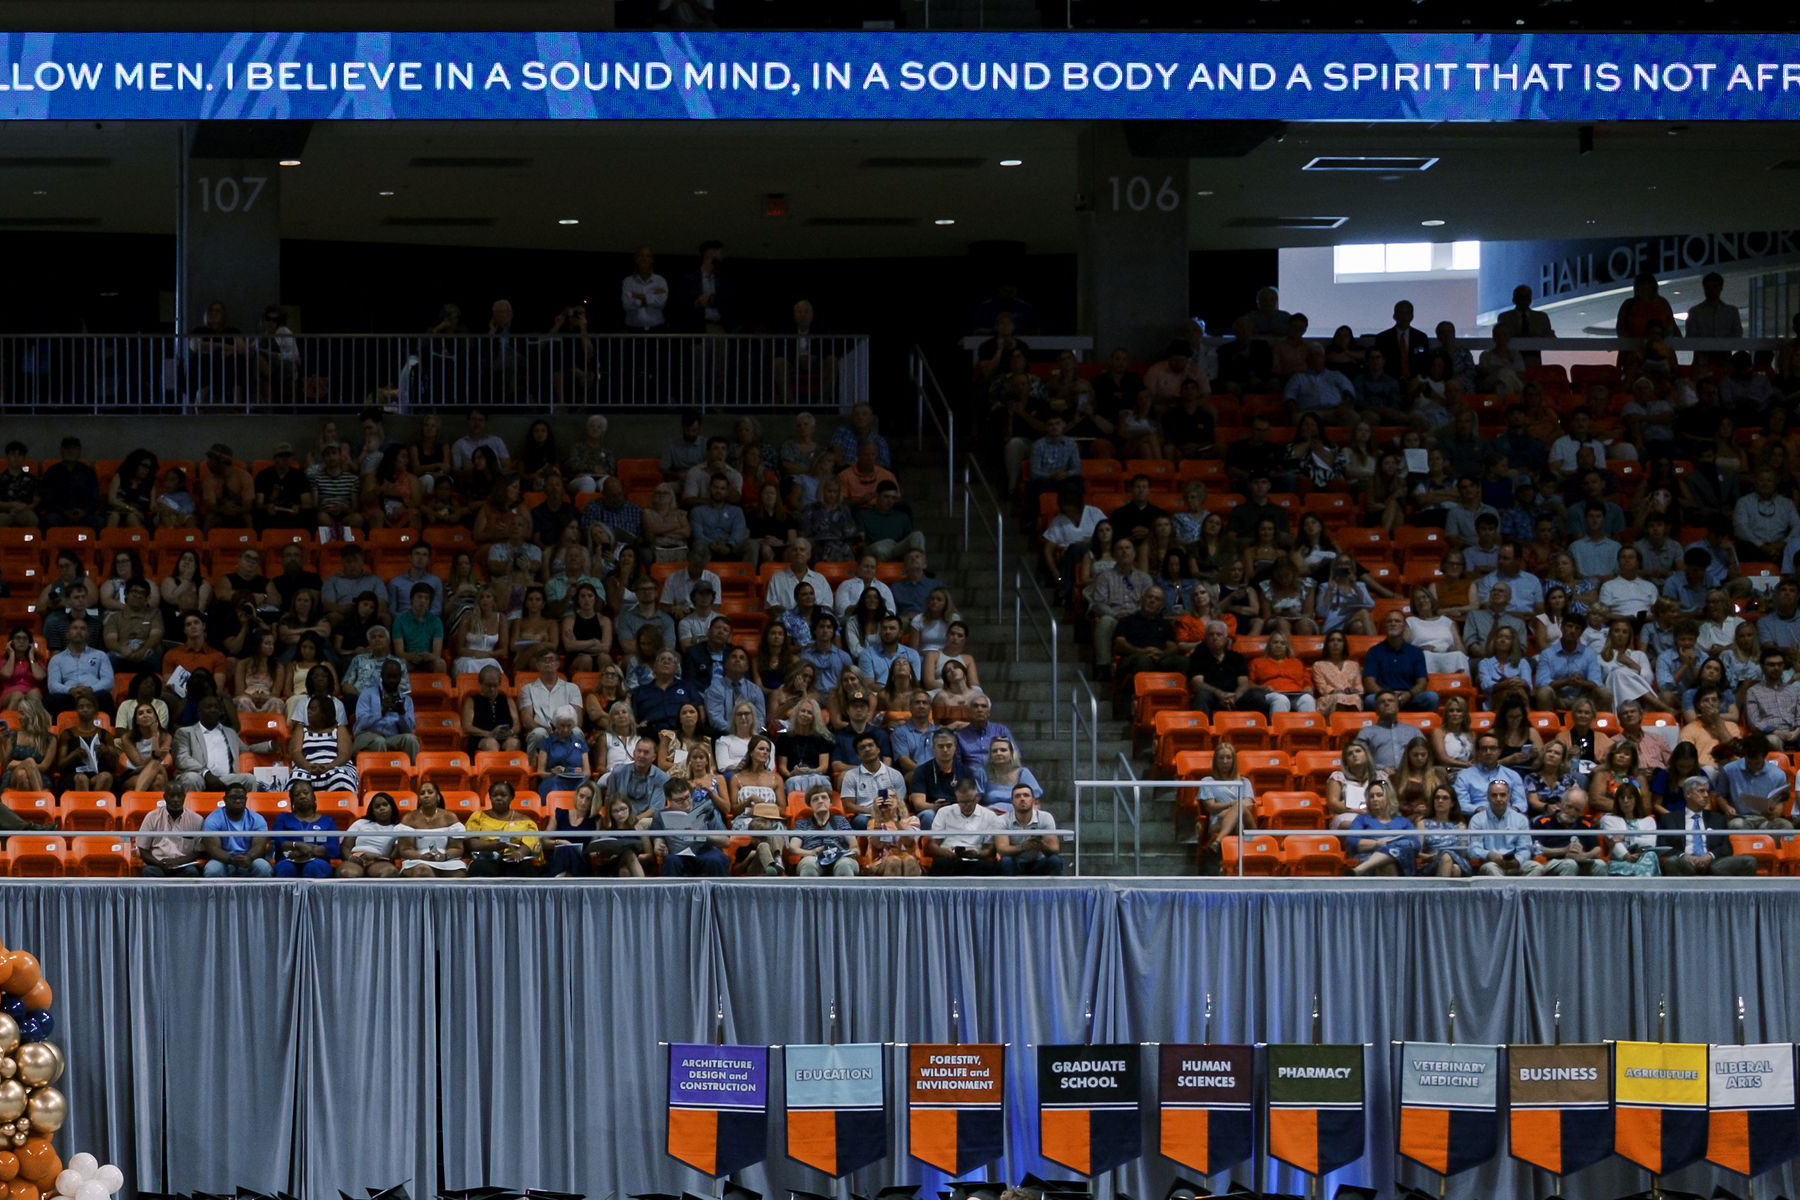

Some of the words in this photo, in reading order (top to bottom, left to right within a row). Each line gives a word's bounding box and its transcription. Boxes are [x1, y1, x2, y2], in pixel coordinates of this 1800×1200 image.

[115, 62, 212, 90] MEN.
[227, 62, 232, 90] I
[247, 62, 422, 90] BELIEVE
[435, 62, 472, 90] IN
[484, 62, 510, 90] A
[522, 62, 671, 90] SOUND
[685, 62, 800, 94] MIND,
[813, 62, 850, 90] IN
[862, 62, 888, 90] A
[900, 62, 1050, 90] SOUND
[1063, 62, 1177, 90] BODY
[1188, 62, 1275, 90] AND
[1286, 62, 1311, 90] A
[1323, 62, 1457, 90] SPIRIT
[1466, 62, 1571, 90] THAT
[1585, 62, 1620, 90] IS
[1634, 62, 1716, 90] NOT
[1727, 63, 1800, 90] AFR
[198, 176, 268, 213] 107
[1108, 175, 1180, 212] 106
[1608, 242, 1648, 282] OF
[1659, 231, 1800, 274] HONOR
[681, 1059, 756, 1071] ARCHITECTURE,
[929, 1055, 982, 1066] FORESTRY,
[1051, 1060, 1126, 1073] GRADUATE
[1181, 1060, 1231, 1072] HUMAN
[1413, 1060, 1486, 1074] VETERINARY
[919, 1067, 967, 1078] WILDLIFE
[969, 1067, 990, 1078] and
[1278, 1067, 1351, 1079] PHARMACY
[1519, 1066, 1598, 1082] BUSINESS
[1624, 1067, 1698, 1081] AGRICULTURE
[1715, 1060, 1773, 1075] LIBERAL
[688, 1070, 726, 1080] DESIGN
[728, 1071, 748, 1081] and
[794, 1068, 873, 1081] EDUCATION
[1418, 1074, 1479, 1088] MEDICINE
[679, 1081, 757, 1092] CONSTRUCTION
[916, 1079, 994, 1090] ENVIRONMENT
[1060, 1076, 1118, 1089] SCHOOL
[1177, 1075, 1236, 1088] SCIENCES
[1726, 1075, 1763, 1090] ARTS
